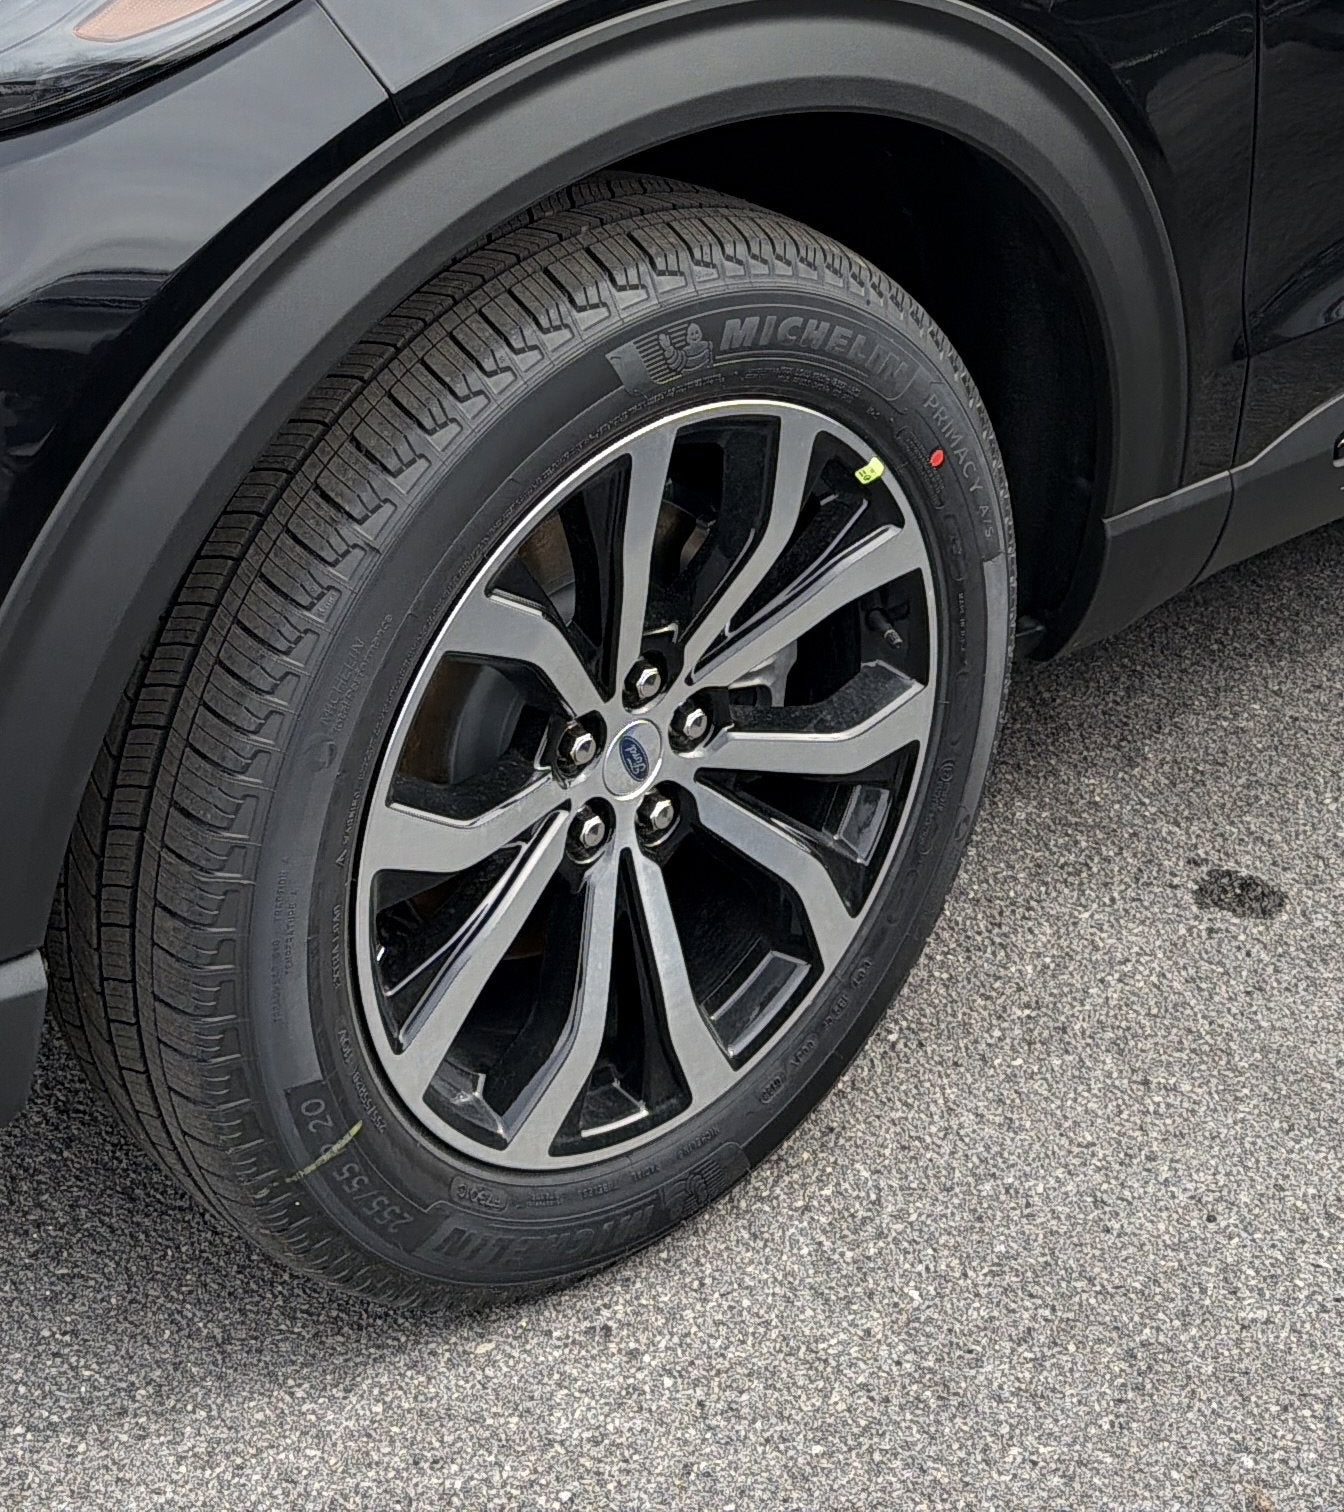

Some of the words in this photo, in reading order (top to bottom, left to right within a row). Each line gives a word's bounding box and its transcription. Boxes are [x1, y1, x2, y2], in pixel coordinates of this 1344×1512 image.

[719, 315, 905, 381] MICHELIN
[923, 394, 983, 494] PRIMACY
[977, 500, 994, 539] A/S
[622, 742, 647, 777] Ford
[300, 1097, 334, 1133] 20
[333, 1160, 414, 1234] 255/55
